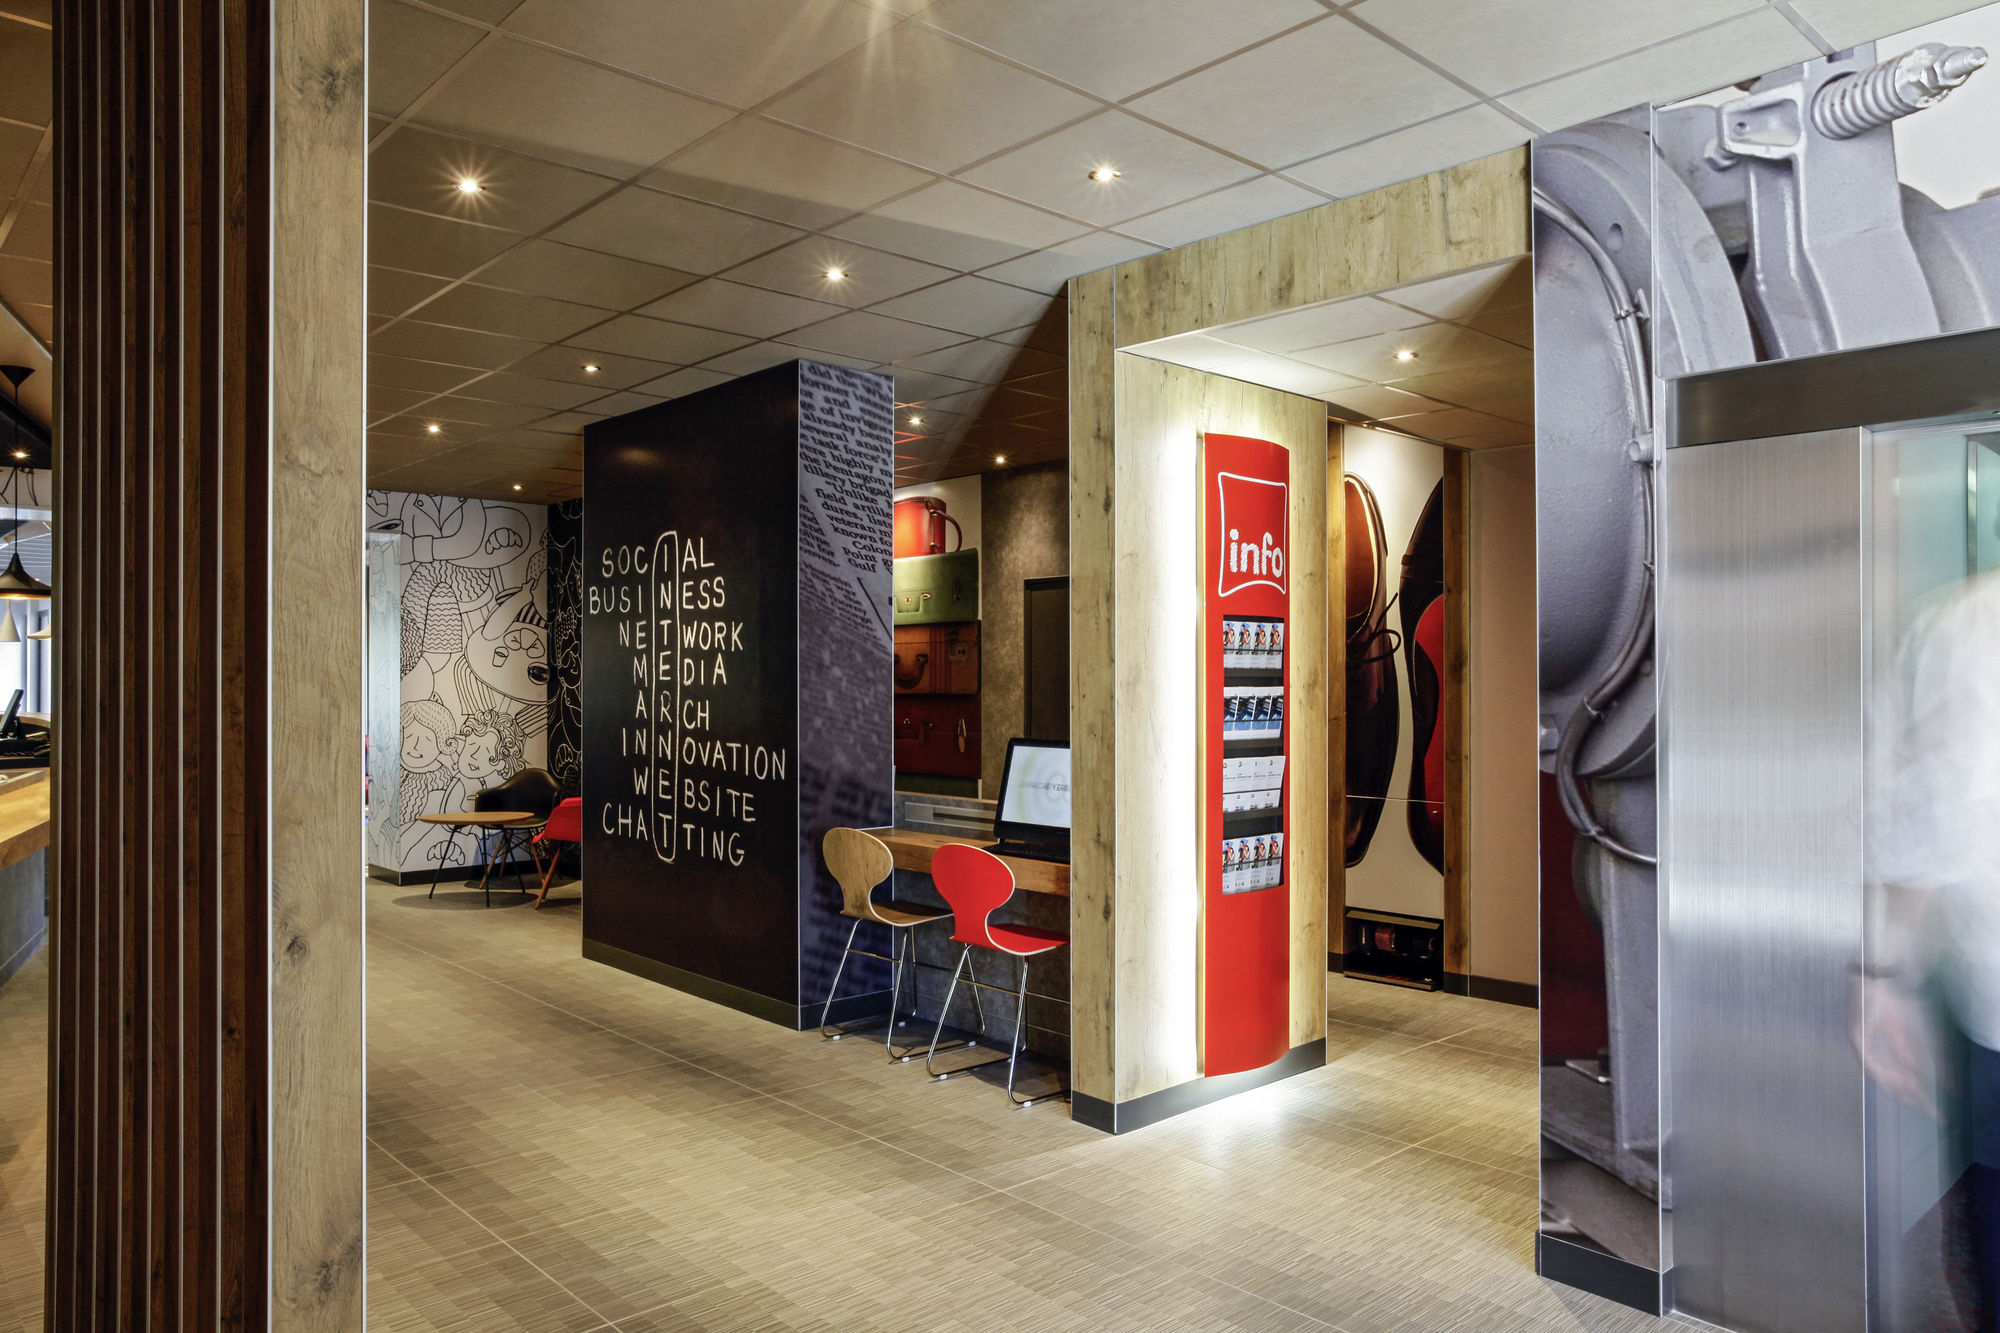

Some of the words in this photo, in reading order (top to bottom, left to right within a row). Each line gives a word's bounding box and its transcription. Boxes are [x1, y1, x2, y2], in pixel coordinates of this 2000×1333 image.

[821, 406, 835, 417] of
[824, 396, 851, 410] and
[803, 412, 855, 436] already
[858, 427, 893, 445] been
[811, 436, 841, 452] task
[800, 452, 821, 466] the
[824, 460, 886, 487] Pentagon
[830, 451, 873, 474] highly
[804, 464, 845, 487] tillery
[848, 478, 893, 499] brigad
[816, 488, 848, 506] field
[822, 501, 863, 522] dures,
[826, 514, 876, 534] veteran
[830, 523, 878, 543] known
[602, 537, 715, 577] SOCIAL
[842, 546, 878, 563] Point
[848, 559, 877, 574] Gulf
[1229, 528, 1284, 578] info
[589, 577, 726, 615] BUSINESS
[619, 619, 744, 651] NETWORK
[633, 651, 727, 687] MEDIA
[633, 767, 756, 822] WEBSITE
[602, 802, 745, 866] CHATTING
